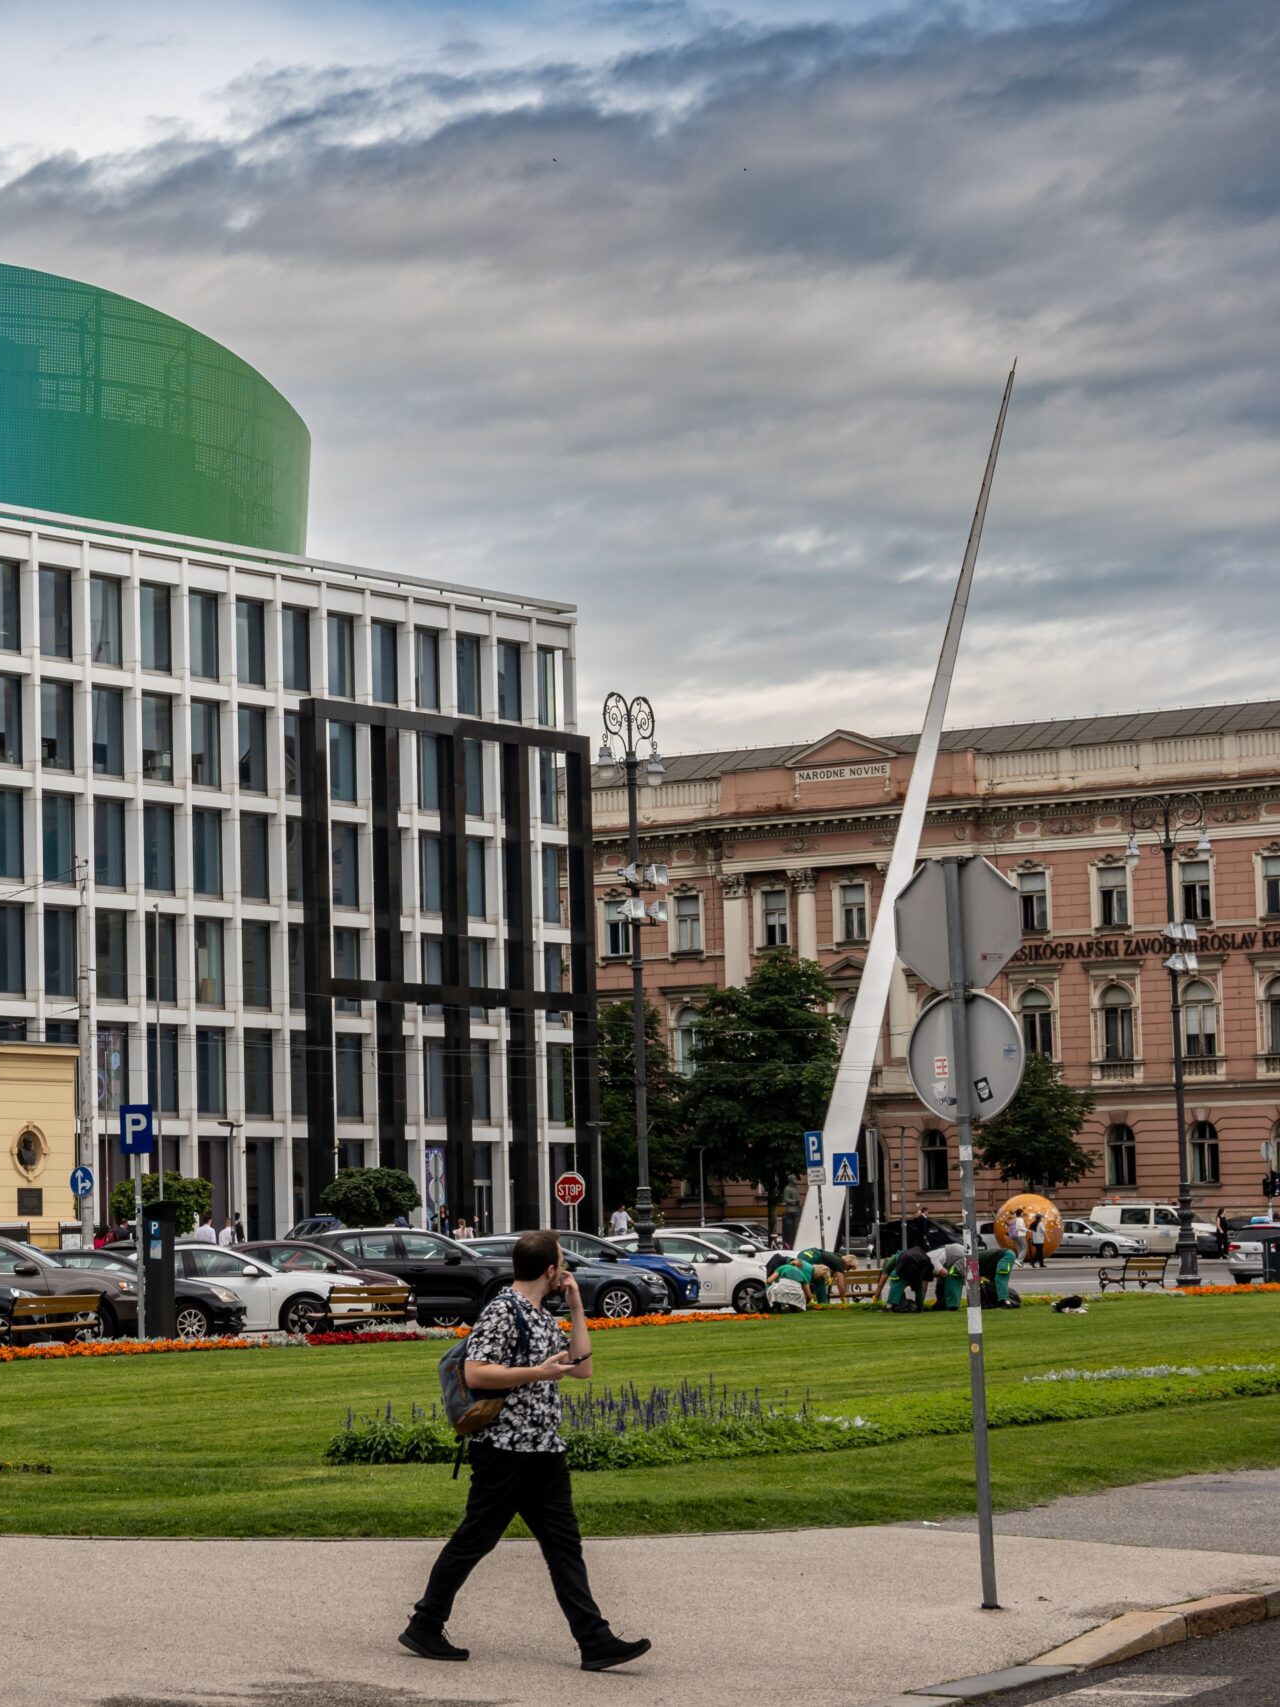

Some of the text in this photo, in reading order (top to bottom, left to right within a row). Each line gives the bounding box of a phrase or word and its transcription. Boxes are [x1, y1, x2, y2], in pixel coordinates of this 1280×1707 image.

[798, 765, 888, 781] NARODNE NOVINE
[1179, 931, 1257, 953] MIROSLAV
[125, 1113, 148, 1145] P
[809, 1136, 819, 1161] P
[558, 1184, 582, 1196] STOP
[151, 1221, 159, 1235] P
